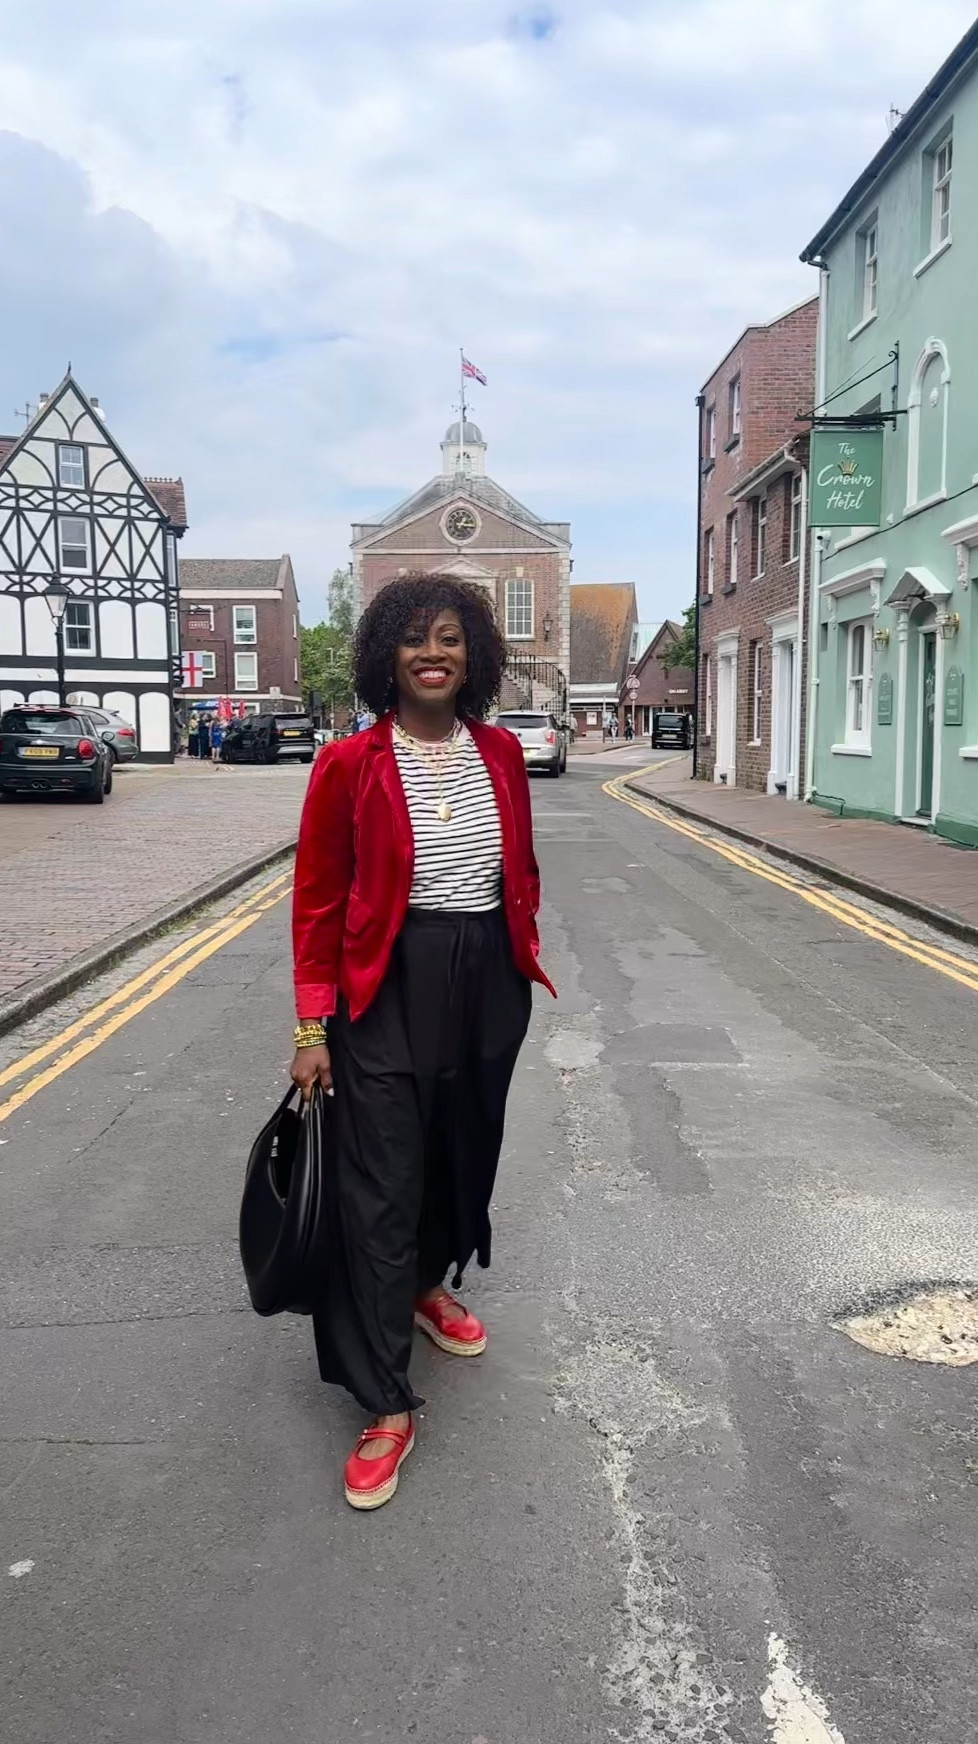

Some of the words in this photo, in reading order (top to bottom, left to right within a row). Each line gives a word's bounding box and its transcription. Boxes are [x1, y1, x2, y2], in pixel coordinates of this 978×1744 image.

[838, 442, 856, 456] The
[817, 463, 875, 487] Crown
[826, 489, 865, 510] Hotel
